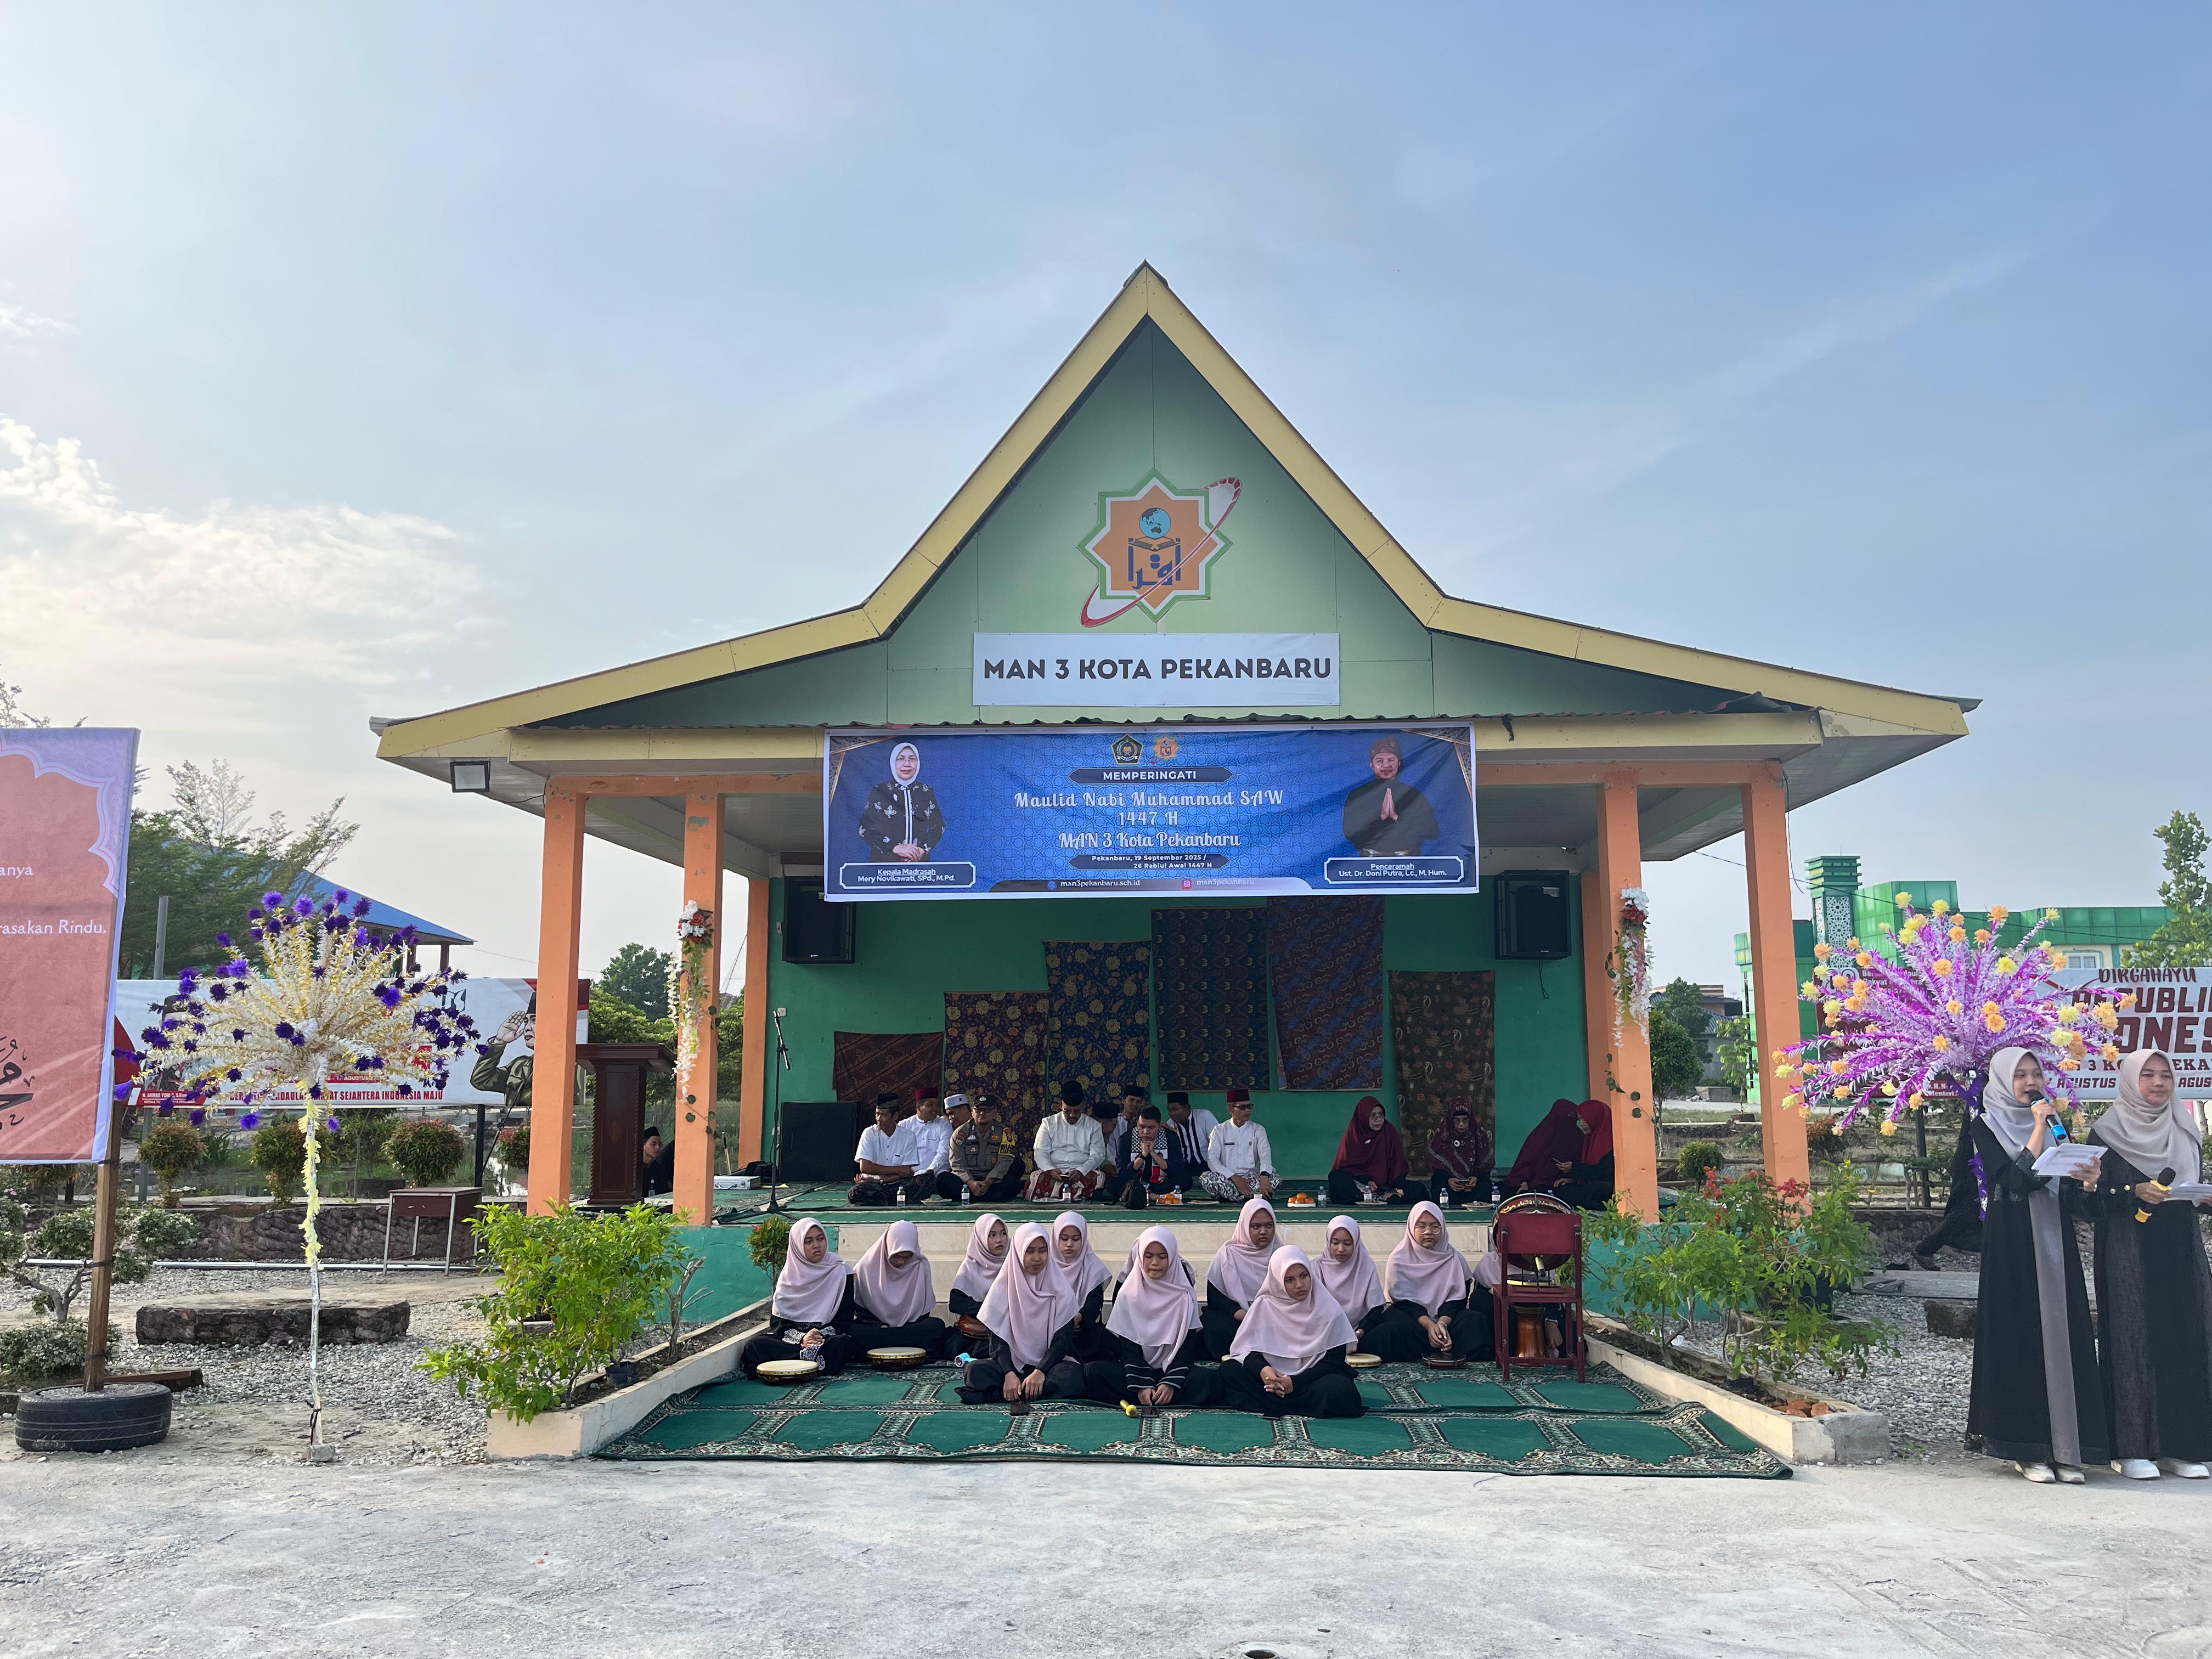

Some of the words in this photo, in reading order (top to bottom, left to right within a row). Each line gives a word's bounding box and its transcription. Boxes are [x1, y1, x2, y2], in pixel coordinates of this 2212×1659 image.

[984, 659, 1046, 680] MAN
[1055, 659, 1070, 680] 3
[1079, 659, 1153, 680] KOTA
[1161, 658, 1331, 679] PEKANBARU
[1103, 771, 1197, 780] MEMPERINGATI
[1014, 793, 1077, 808] Maulid
[1082, 792, 1126, 806] Nabi
[1131, 791, 1235, 806] Muhammad
[1240, 789, 1283, 806] SAW
[1119, 810, 1158, 826] 1447
[1165, 810, 1179, 825] H
[1058, 832, 1098, 850] MAN
[1103, 832, 1113, 848] 3
[1116, 832, 1154, 848] Kota
[1155, 831, 1242, 847] Pekanbaru
[1060, 879, 1141, 887] man3pekanbaru.sch.id
[1196, 878, 1255, 887] man3pekanbaru
[58, 919, 106, 934] Rindu,
[2098, 967, 2197, 983] DIRGAHAYU
[2088, 1059, 2097, 1071] 3
[340, 1091, 380, 1101] SEJAHTERA
[423, 1090, 443, 1101] MAJU
